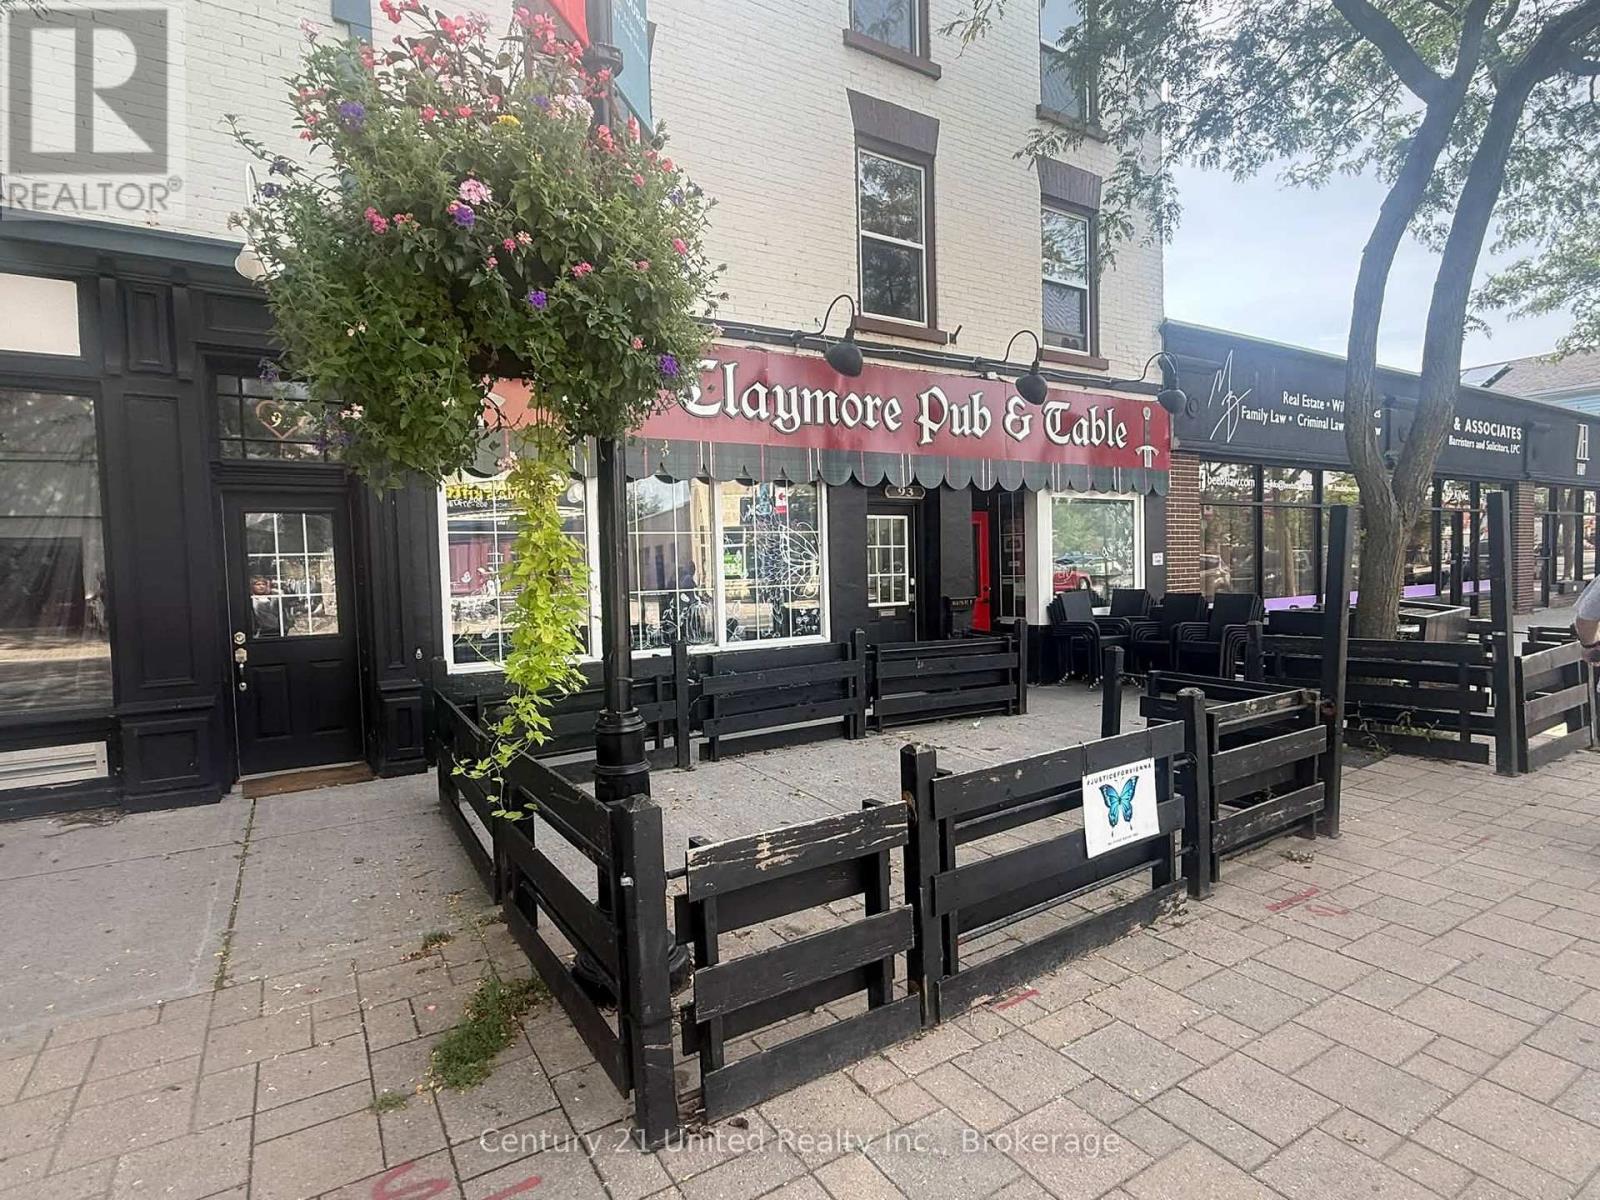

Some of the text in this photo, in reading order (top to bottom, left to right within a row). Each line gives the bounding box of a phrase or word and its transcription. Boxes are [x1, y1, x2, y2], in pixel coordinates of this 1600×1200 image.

[678, 359, 1128, 449] Claymore Pub & Table
[1282, 391, 1300, 406] Real
[1301, 394, 1325, 410] Estate
[1241, 406, 1345, 431] Family Law Criminal Law
[1453, 416, 1522, 440] & ASSOCIATES
[1448, 434, 1475, 449] Barristers
[1475, 440, 1486, 451] and
[896, 486, 914, 497] 93
